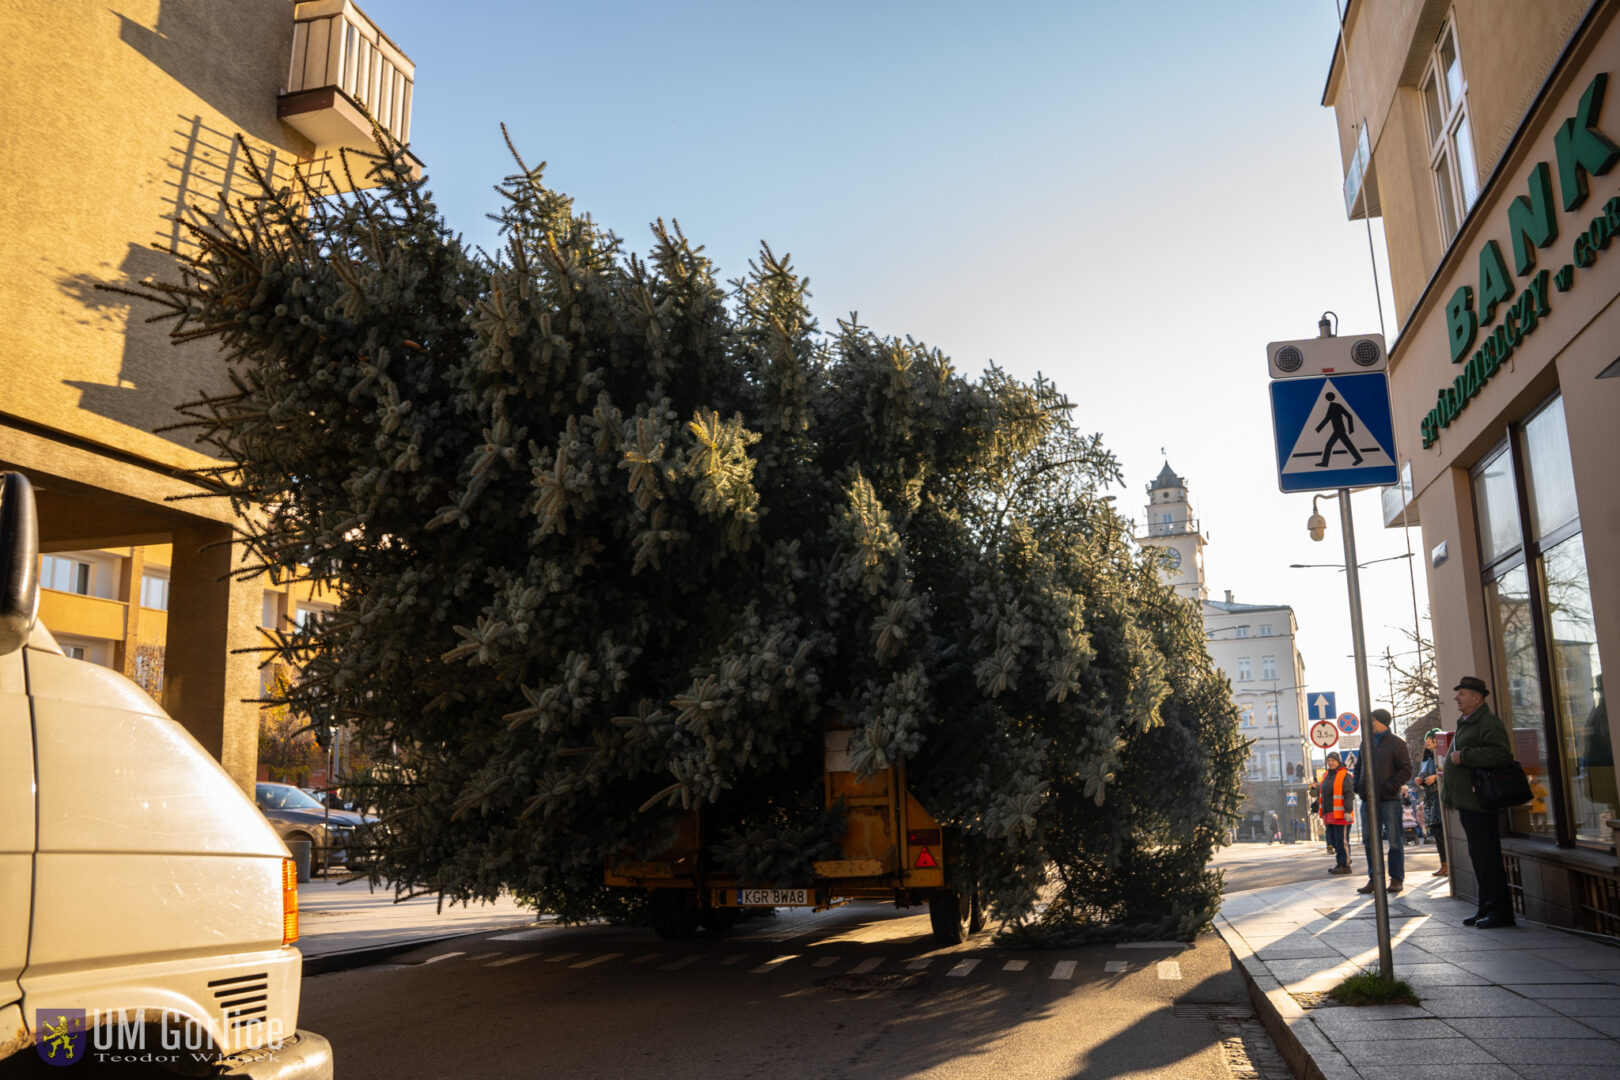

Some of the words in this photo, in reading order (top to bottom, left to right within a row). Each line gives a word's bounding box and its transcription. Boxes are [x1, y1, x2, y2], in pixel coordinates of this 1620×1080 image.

[1446, 72, 1620, 364] BANK
[1421, 269, 1550, 450] SPÓŁDZIELCZY
[745, 890, 769, 903] KGR
[773, 890, 805, 904] 8WA8
